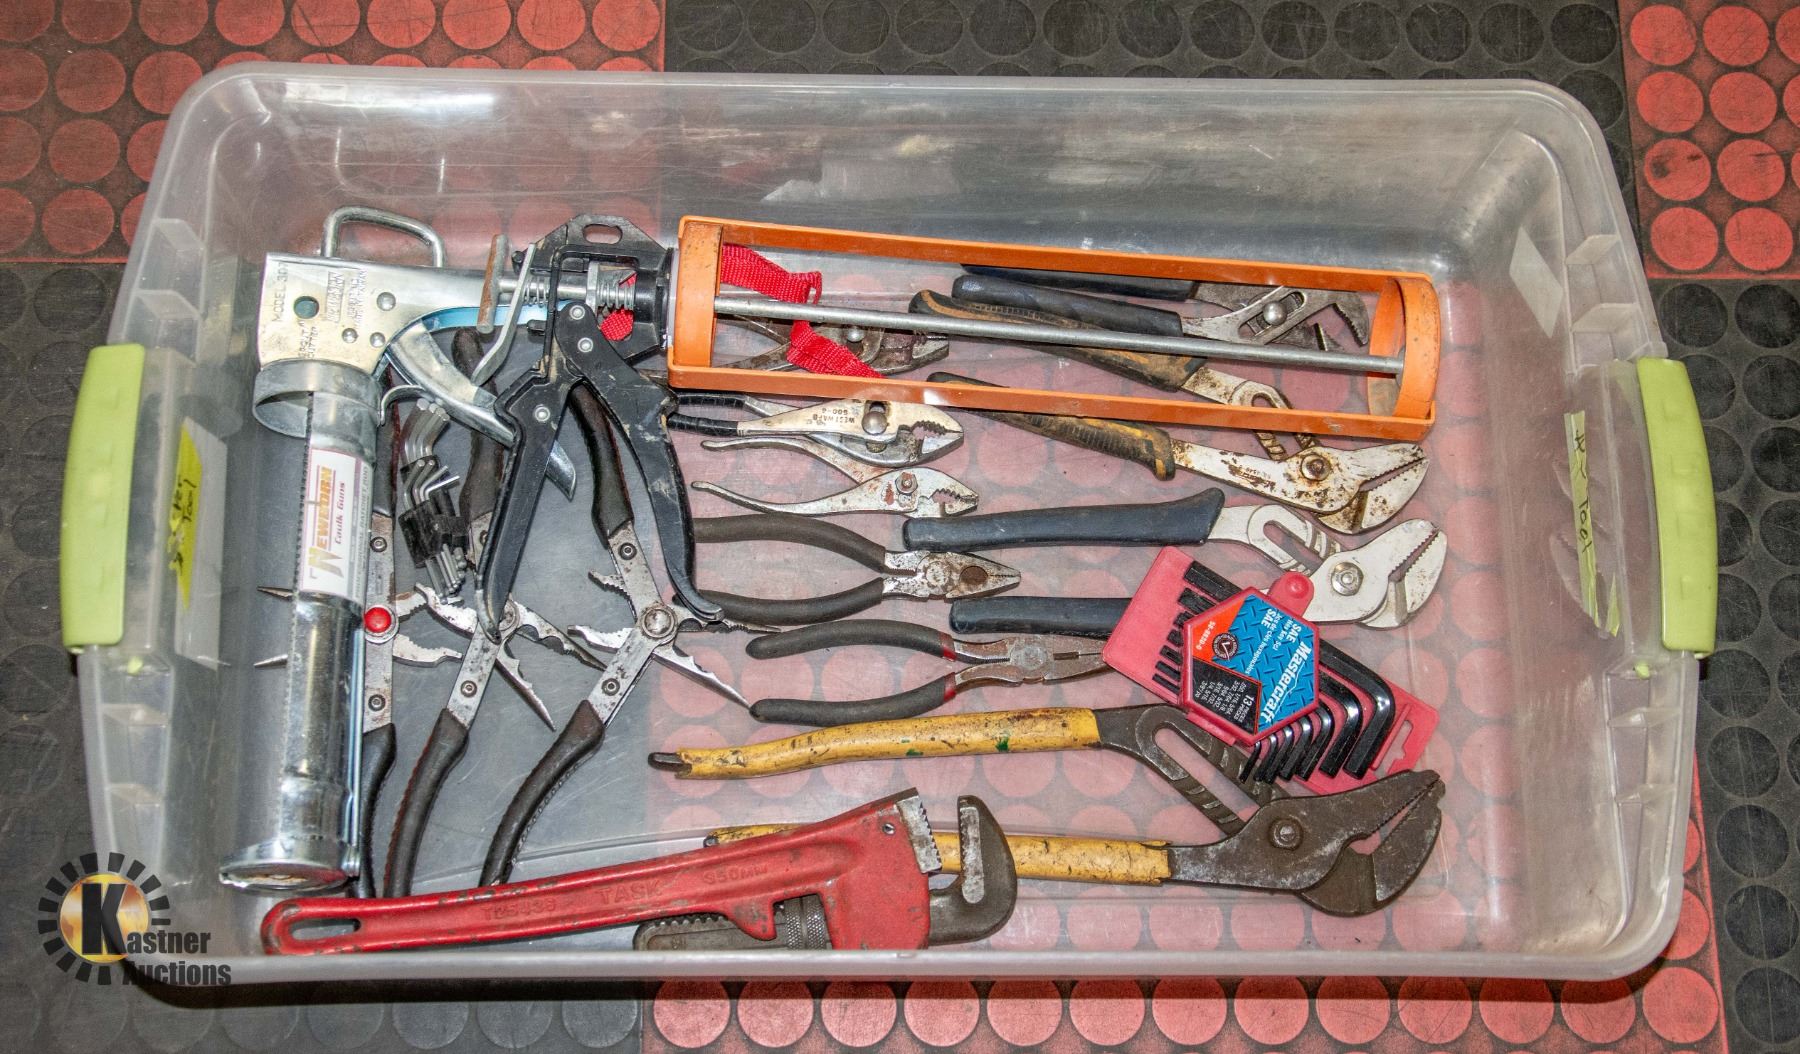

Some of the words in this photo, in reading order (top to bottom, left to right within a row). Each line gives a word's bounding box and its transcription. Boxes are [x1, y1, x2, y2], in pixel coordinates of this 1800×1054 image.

[271, 284, 286, 321] MODEL
[336, 482, 345, 511] Guns
[308, 466, 344, 578] NEWBORN
[335, 513, 345, 545] Caulk
[1261, 609, 1277, 627] SAE
[1286, 624, 1301, 643] SAE
[1261, 643, 1311, 723] Mastercraft
[1242, 693, 1254, 706] 13
[601, 880, 661, 903] TASK
